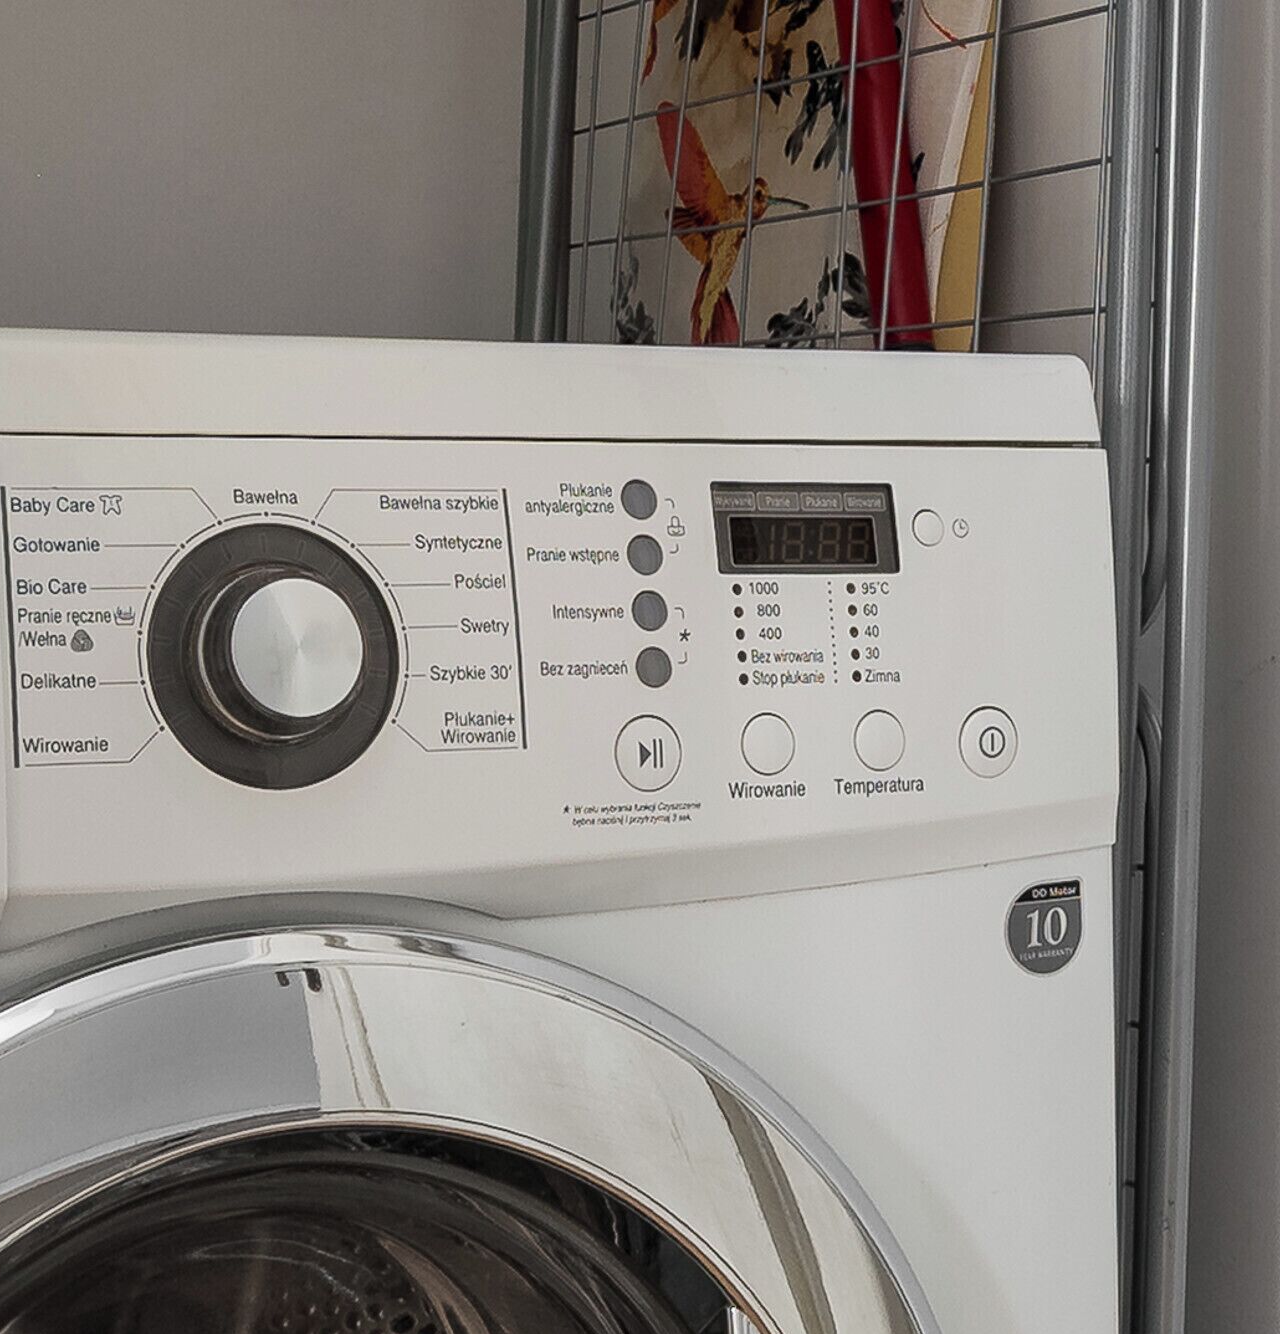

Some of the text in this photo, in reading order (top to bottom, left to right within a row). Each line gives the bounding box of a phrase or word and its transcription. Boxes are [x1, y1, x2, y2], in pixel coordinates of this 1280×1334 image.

[233, 489, 298, 505] Bawełna
[380, 495, 499, 513] Bawełna szybkie
[10, 496, 95, 517] Baby Care
[525, 499, 615, 515] antyalergiczne
[13, 537, 101, 553] Gotowanie
[415, 535, 502, 552] Syntetyczne
[526, 546, 620, 565] Pranie wstępne
[16, 578, 87, 595] Bio Care
[454, 573, 506, 590] Pościel
[749, 582, 779, 595] 1000
[17, 608, 111, 627] Pranie ręczne
[553, 605, 624, 622] Intensywne
[757, 605, 781, 617] 800
[863, 604, 878, 617] 60
[460, 618, 510, 636] Swetry
[758, 627, 782, 640] 400
[864, 625, 879, 639] 40
[751, 648, 824, 664] Bez wirowania
[865, 647, 880, 660] 30
[430, 665, 486, 685] Szybkie
[540, 660, 628, 679] Bez zagnieceń
[865, 669, 901, 682] Zimna
[21, 673, 96, 690] Delikatne
[752, 670, 778, 688] Stop
[444, 710, 516, 727] Płukanie+
[23, 736, 109, 752] Wirowanie
[440, 728, 516, 744] Wirowanie
[729, 780, 806, 798] Wirowanie
[834, 777, 924, 798] Temperatura
[1026, 906, 1067, 949] 10
